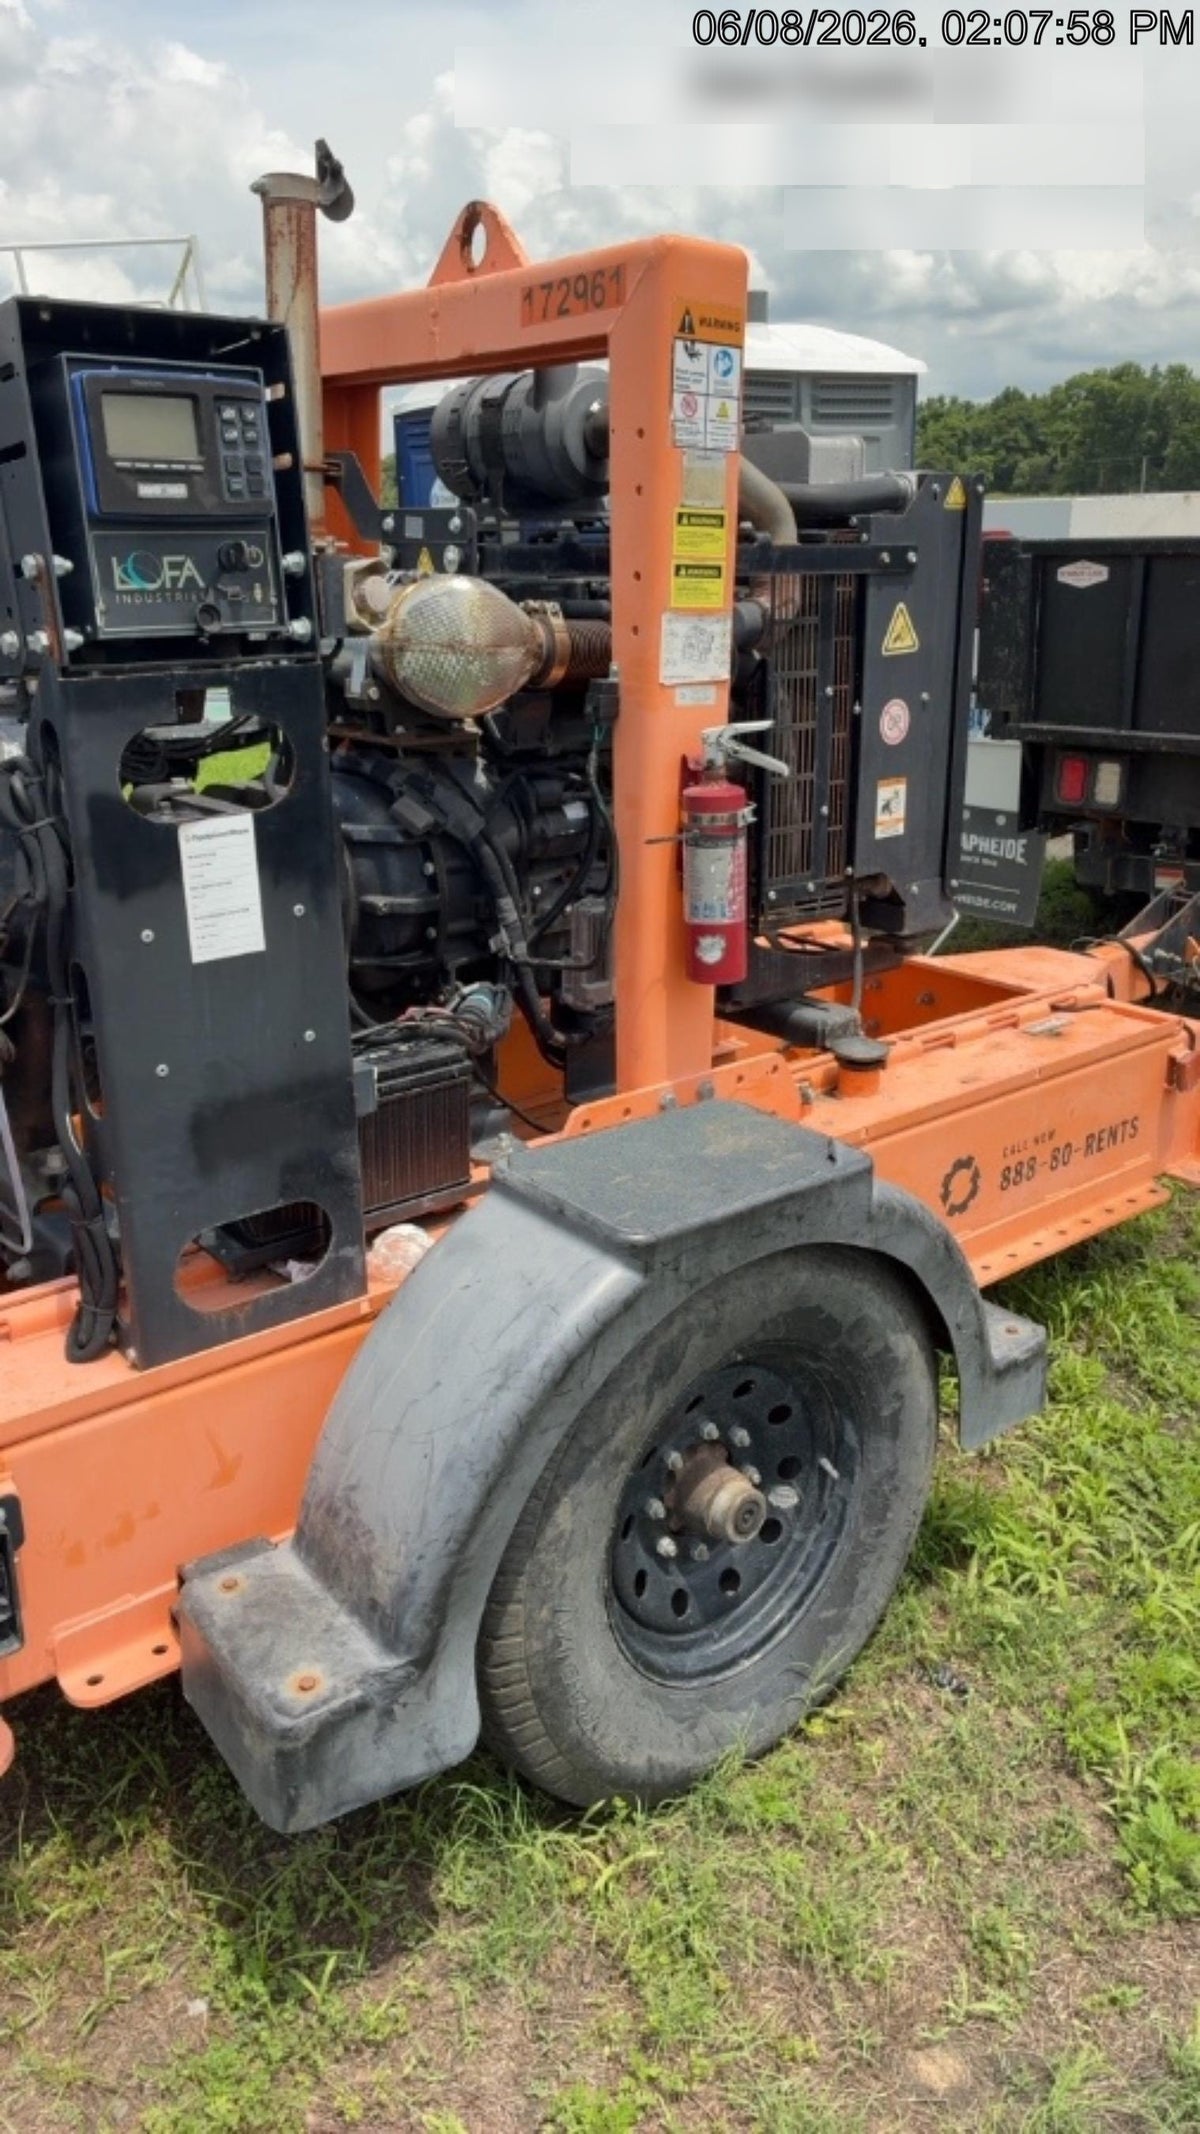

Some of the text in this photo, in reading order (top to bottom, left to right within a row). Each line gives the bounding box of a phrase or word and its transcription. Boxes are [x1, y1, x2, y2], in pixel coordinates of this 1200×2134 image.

[522, 264, 625, 323] 172961
[1000, 1116, 1140, 1191] 888-80-RENTS
[1002, 1129, 1056, 1158] CALL NOW
